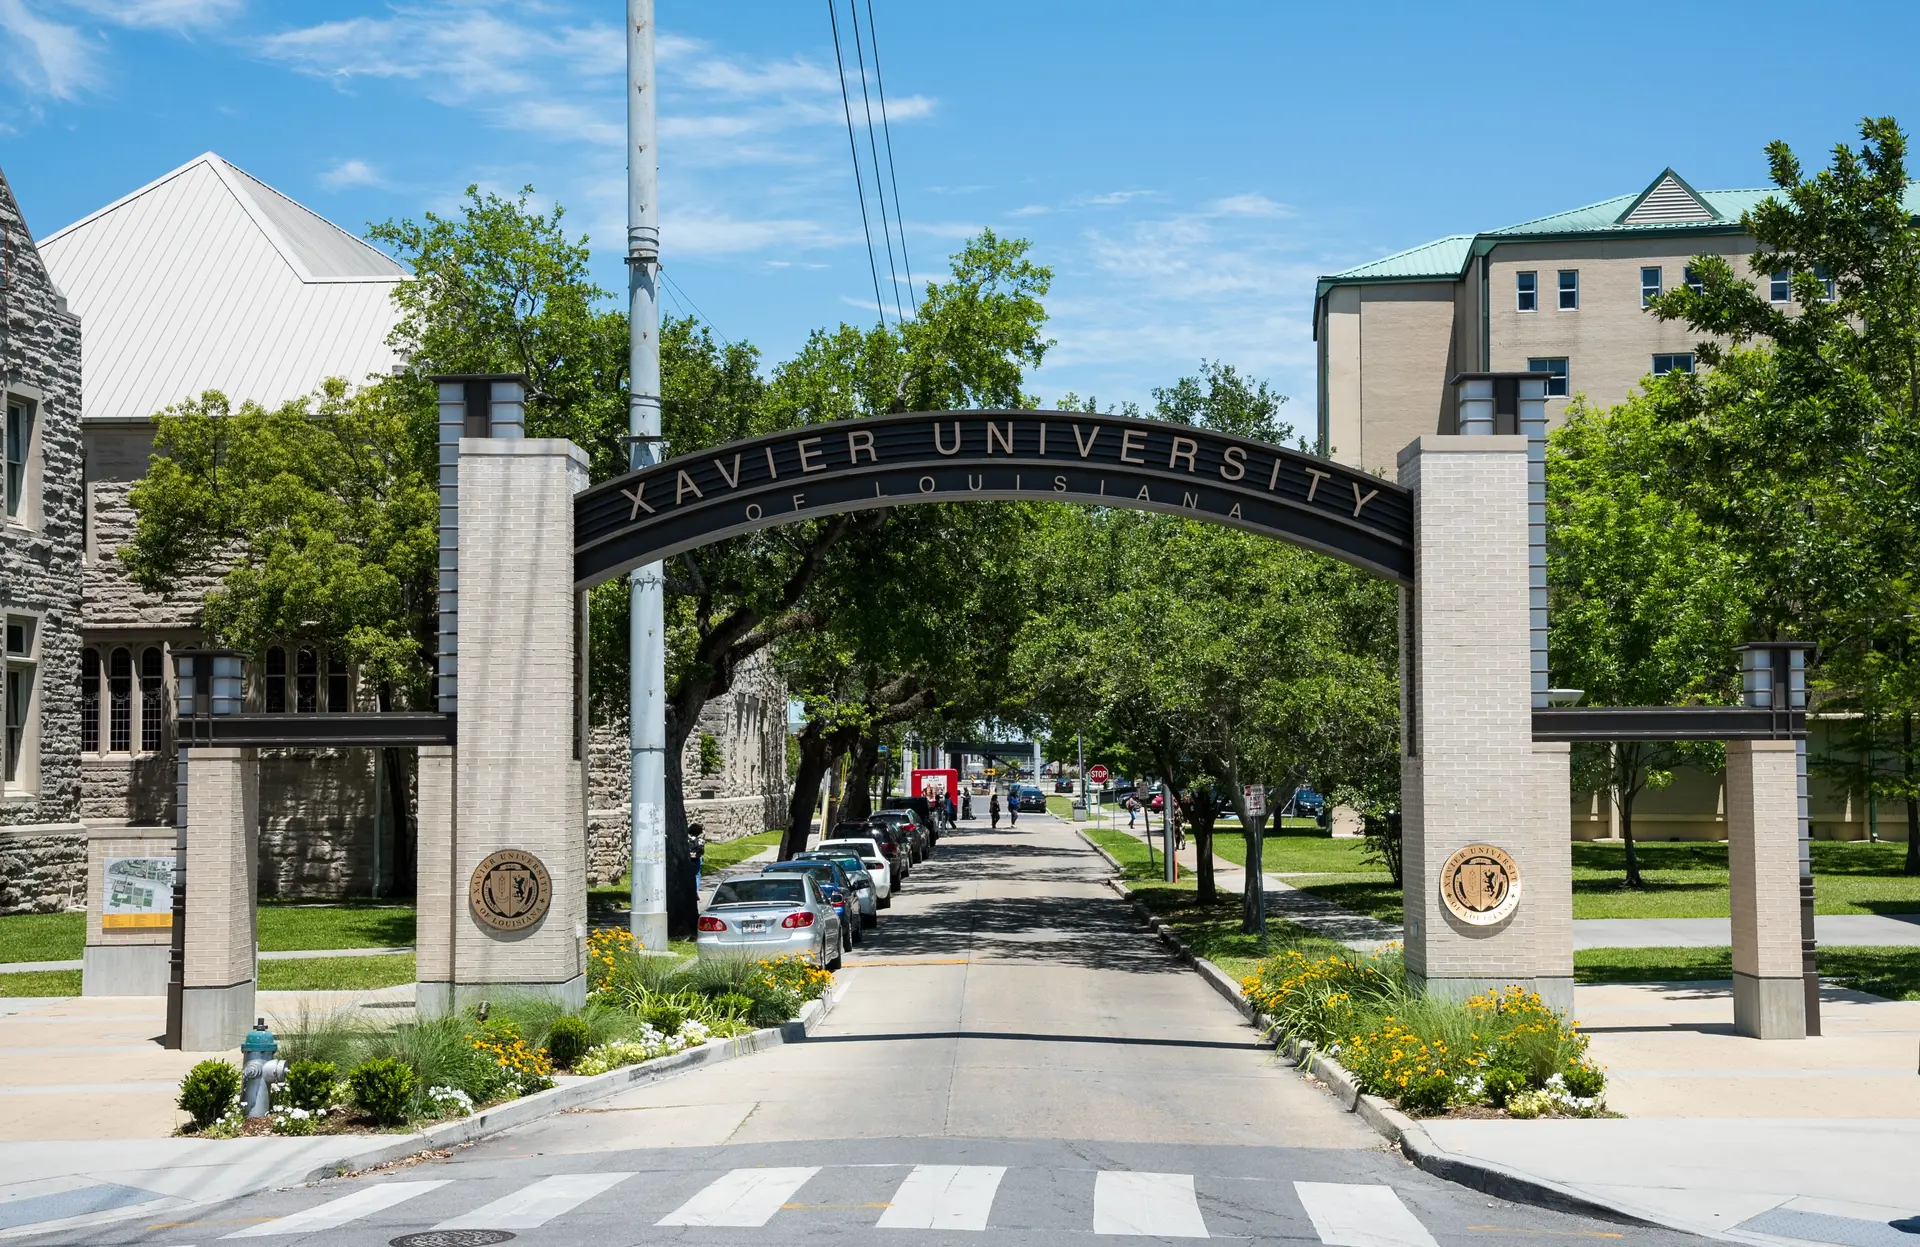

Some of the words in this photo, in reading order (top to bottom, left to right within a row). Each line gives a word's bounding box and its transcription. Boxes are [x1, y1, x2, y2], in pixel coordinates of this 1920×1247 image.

[620, 430, 878, 521] XAVIER
[934, 421, 1379, 517] UNIVERSITY
[745, 493, 805, 521] OF
[875, 474, 1242, 520] LOUISIANA
[1091, 770, 1107, 778] STOP
[473, 858, 496, 894] XAVIER
[500, 852, 548, 893] UNIVERSITY
[1444, 852, 1466, 888] XAVIER
[1470, 847, 1518, 888] UNIVERSITY
[479, 907, 492, 918] OF
[491, 907, 542, 927] LOUISIANA
[1450, 901, 1461, 911] OF
